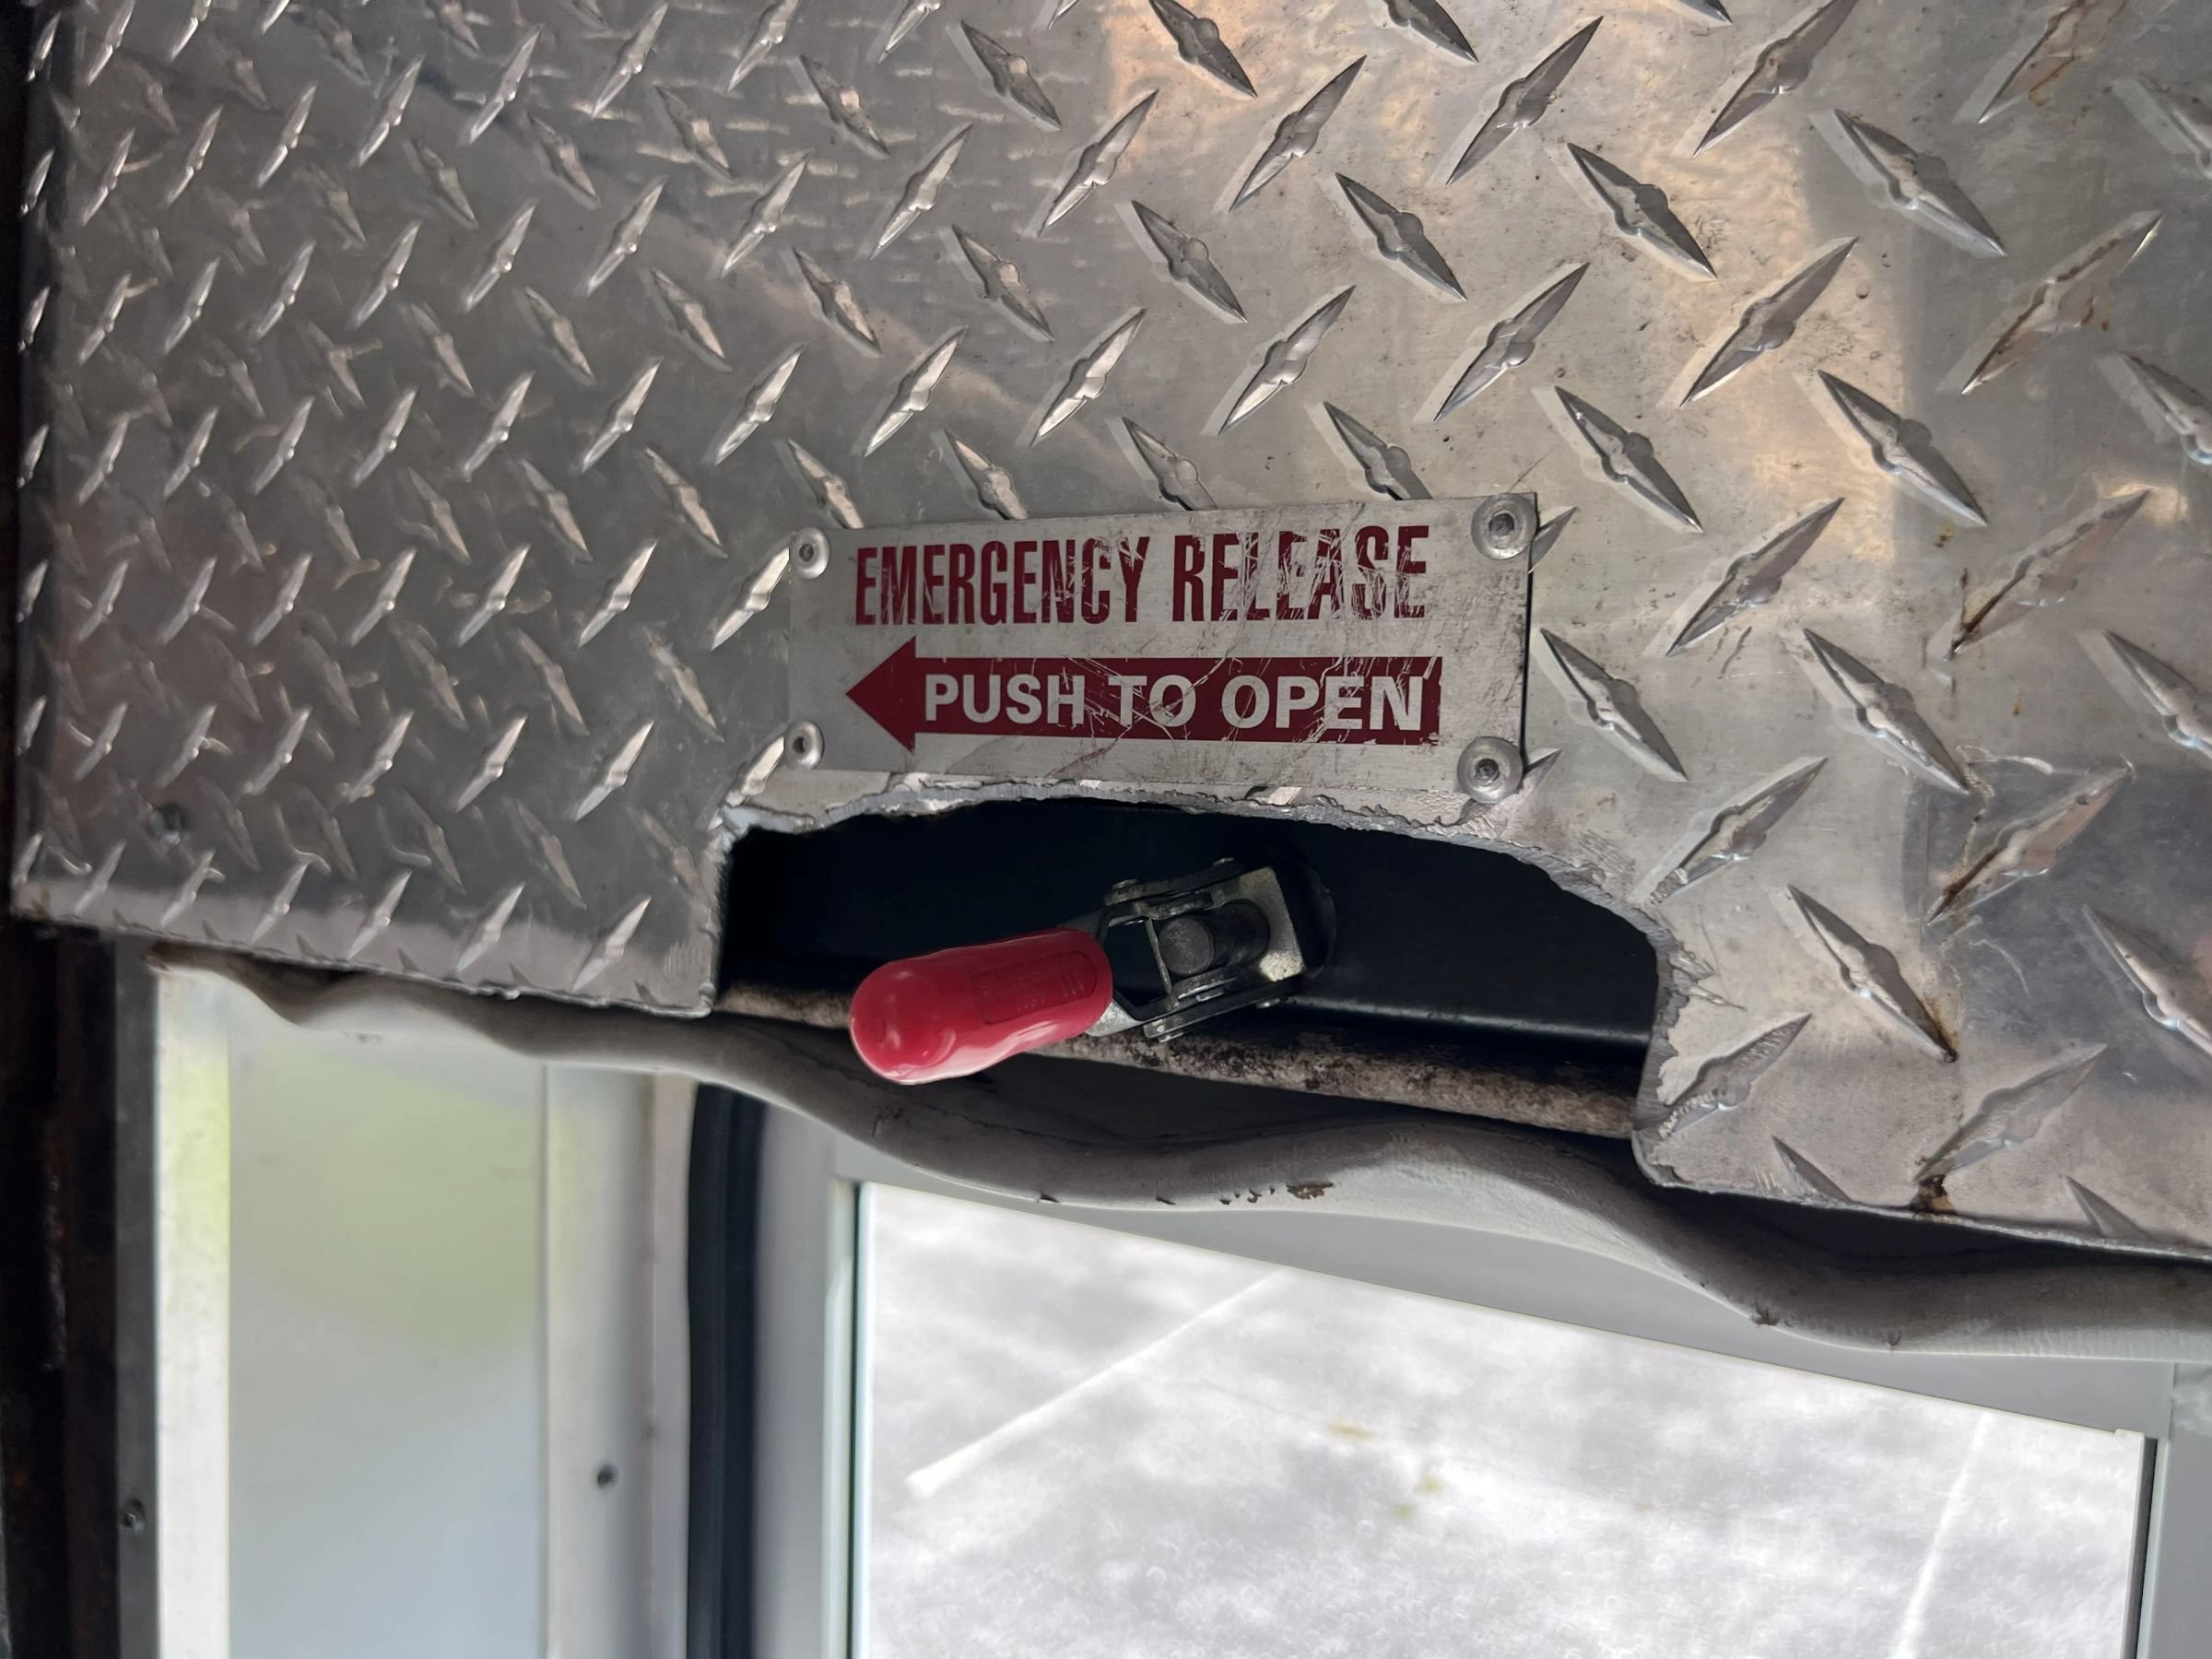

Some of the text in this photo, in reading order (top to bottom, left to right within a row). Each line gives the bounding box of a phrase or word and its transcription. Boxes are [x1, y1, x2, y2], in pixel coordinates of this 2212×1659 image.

[855, 524, 1430, 626] EMERGENCY RELEASE
[924, 674, 1425, 732] PUSH TO OPEN
